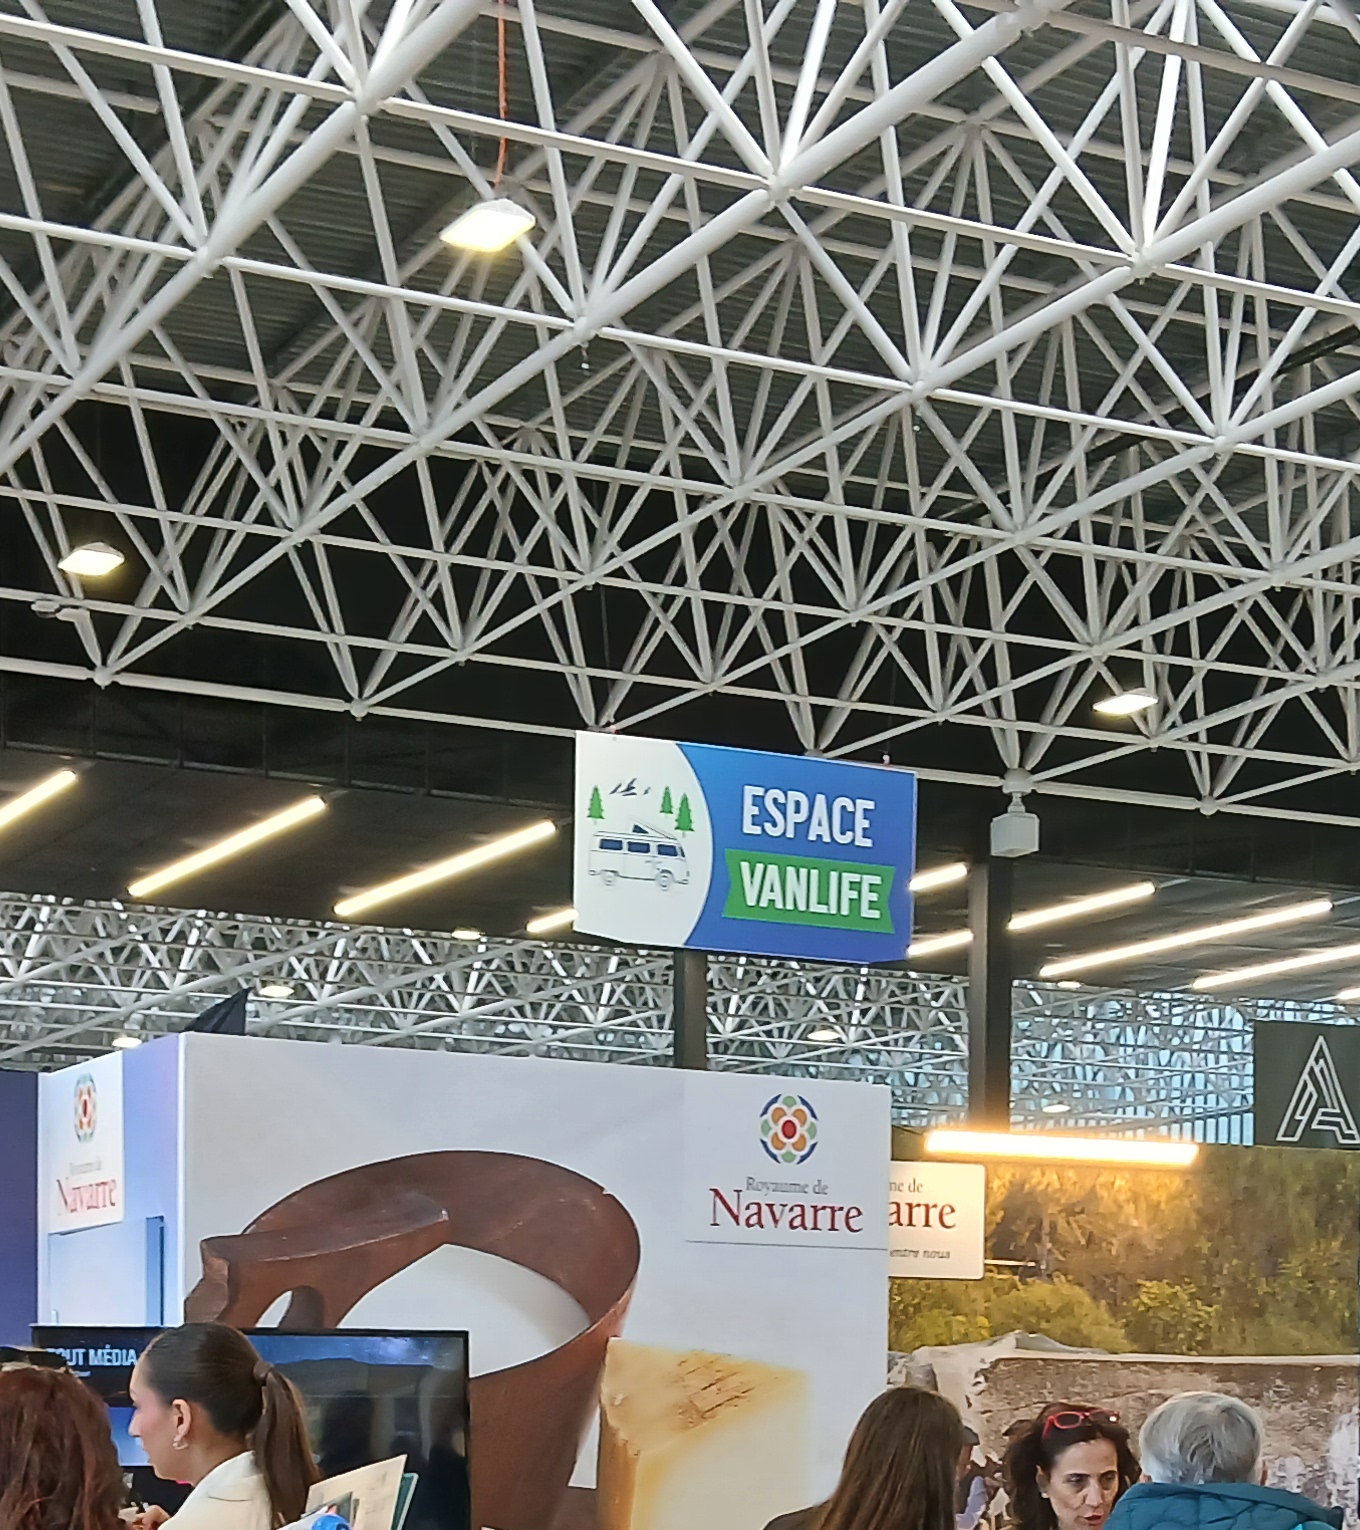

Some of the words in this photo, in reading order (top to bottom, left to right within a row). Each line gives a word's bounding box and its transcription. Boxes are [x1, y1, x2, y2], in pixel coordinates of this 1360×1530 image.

[742, 784, 877, 848] ESPACE
[739, 860, 883, 919] VANLIFE
[745, 1176, 809, 1197] Royaume
[812, 1178, 829, 1196] de
[907, 1177, 924, 1194] de
[709, 1187, 865, 1234] Navarre
[88, 1343, 137, 1367] MÉDIA
